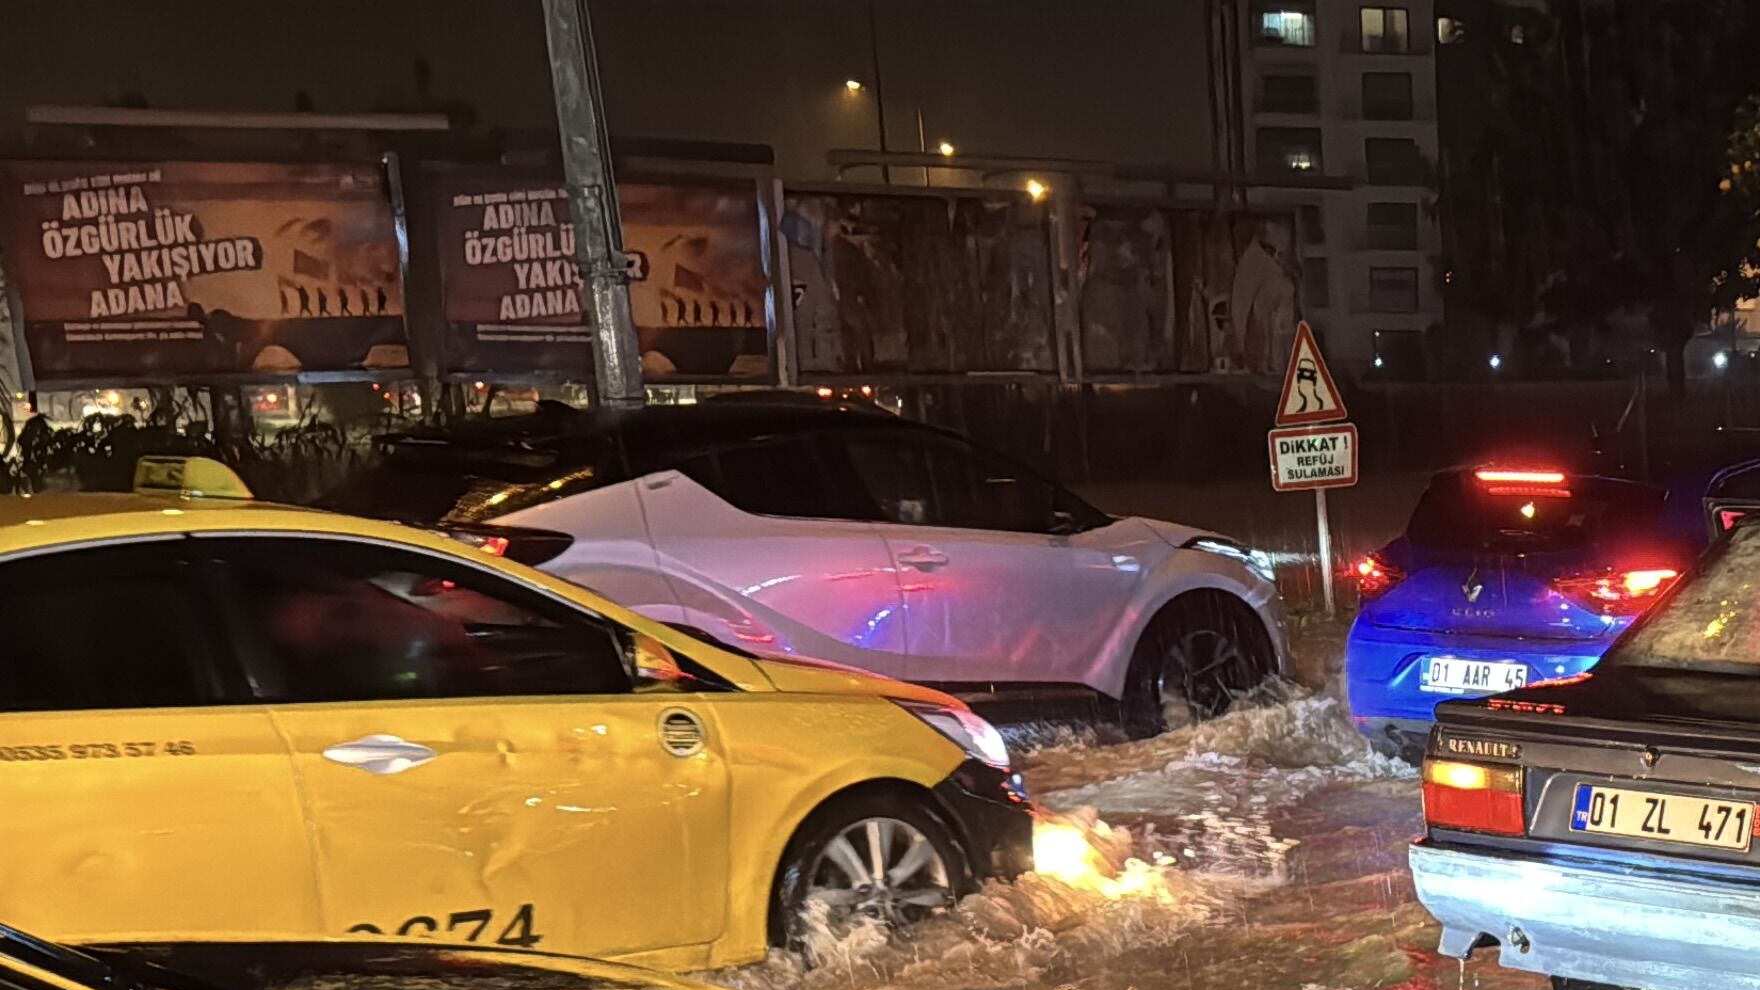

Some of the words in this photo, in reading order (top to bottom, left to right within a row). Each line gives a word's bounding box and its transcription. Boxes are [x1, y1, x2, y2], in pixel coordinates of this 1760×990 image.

[62, 186, 149, 221] ADINA
[483, 201, 557, 231] ADINA
[41, 208, 197, 259] ÖZGÜRLÜK
[465, 223, 576, 265] ÖZGÜRLÜ
[103, 239, 256, 284] YAKIŞIYOR
[90, 280, 185, 318] ADANA
[500, 289, 580, 321] ADANA
[1287, 466, 1345, 480] SULAMASI
[1297, 453, 1334, 467] REFÜJ
[1431, 662, 1449, 683] 01
[1462, 665, 1491, 687] AAR
[1505, 668, 1524, 688] 45
[1449, 739, 1509, 757] RENAULT
[1576, 810, 1588, 822] TR
[1590, 792, 1619, 828] 01
[1641, 798, 1671, 834] ZL
[1698, 804, 1747, 843] 471
[344, 903, 544, 948] 74
